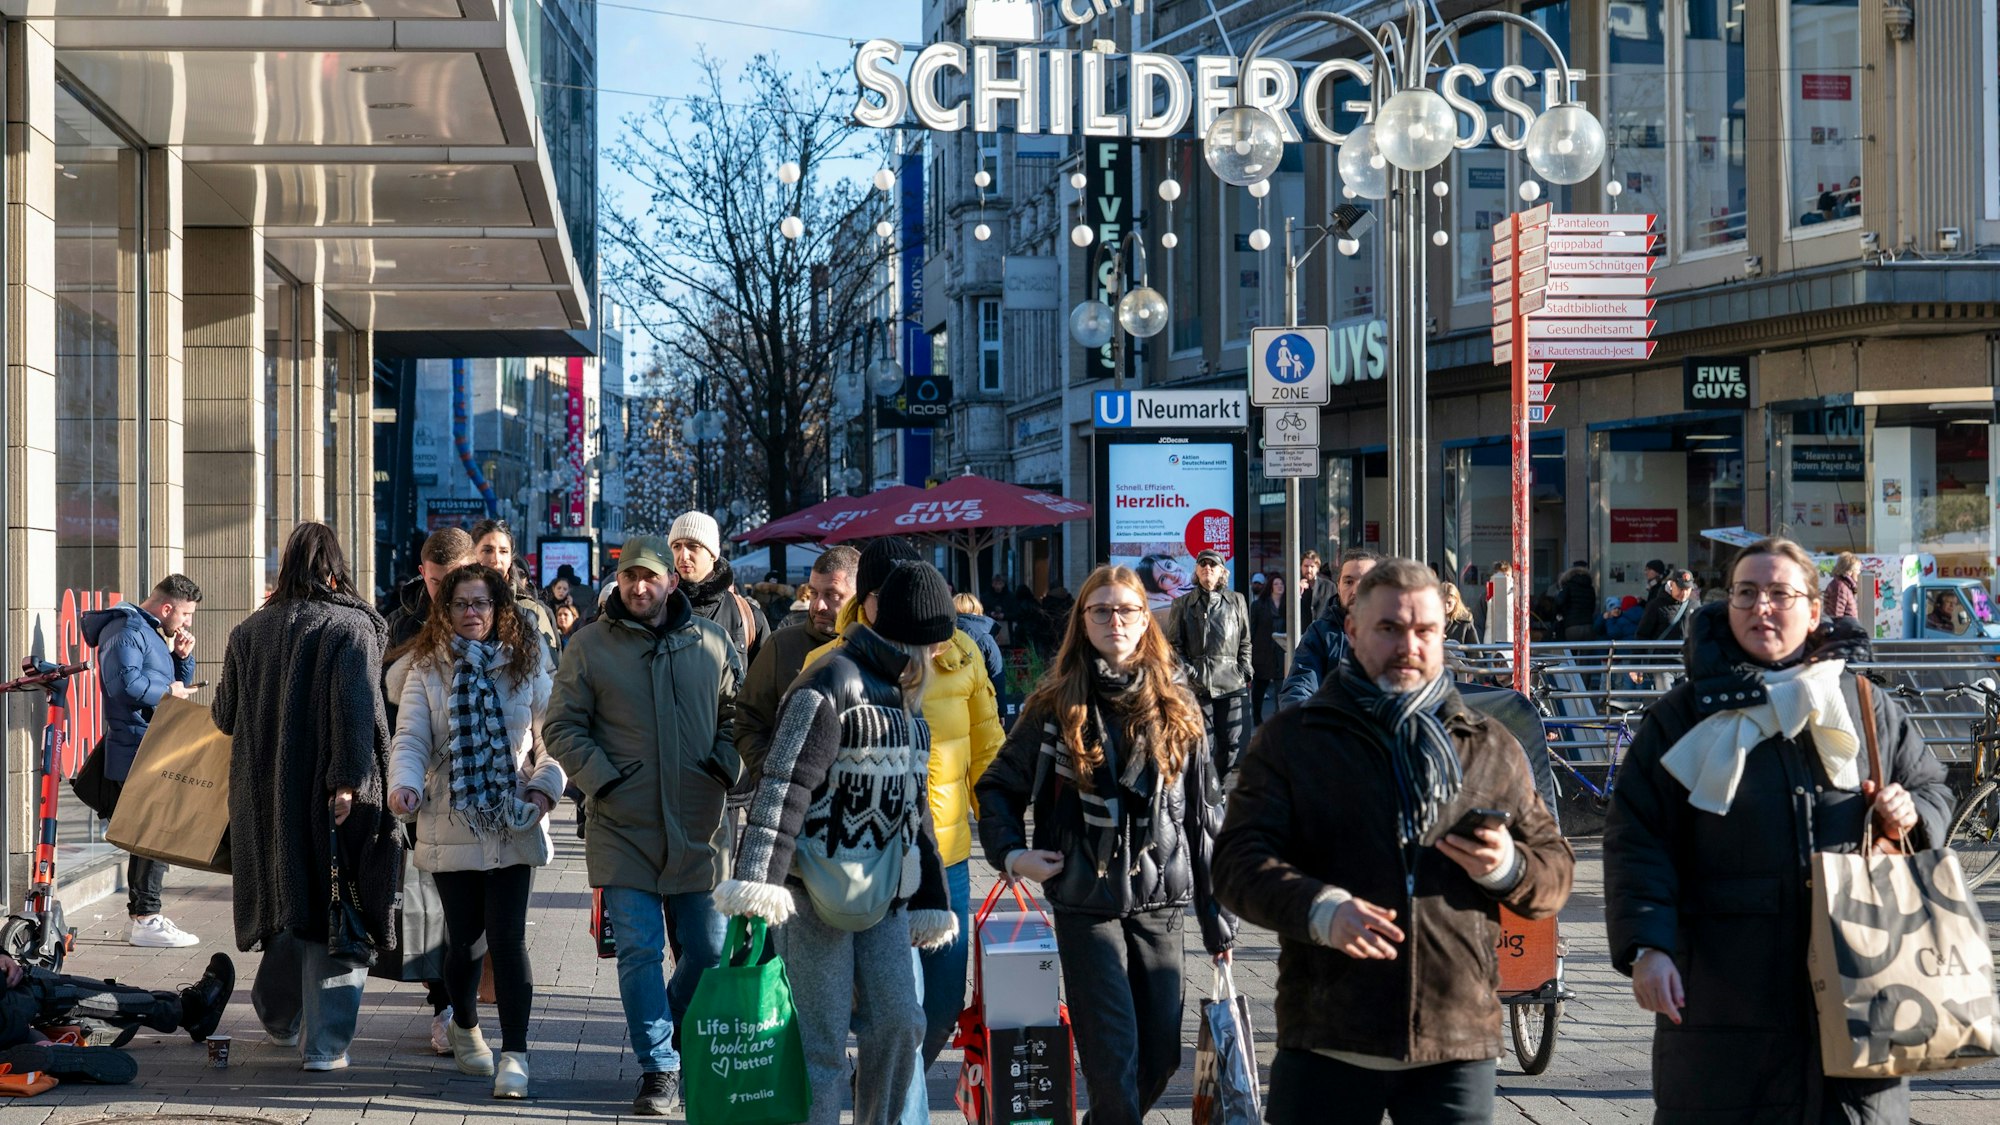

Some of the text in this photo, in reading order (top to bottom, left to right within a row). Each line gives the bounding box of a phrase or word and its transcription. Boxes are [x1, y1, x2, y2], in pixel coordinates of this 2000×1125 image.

[852, 38, 1587, 150] SCHILDERGSS
[1098, 143, 1122, 249] FIVE
[1558, 218, 1609, 228] Pantaleon
[1548, 239, 1603, 251] grippabad
[1589, 260, 1644, 272] Schnütgen
[1548, 282, 1569, 291] VHS
[1547, 303, 1627, 313] Stadtbibliothek
[1547, 324, 1633, 335] Gesundheitsamt
[1548, 346, 1634, 357] Rautenstrauch-Joest
[1697, 366, 1741, 382] FIVE
[1272, 387, 1309, 399] ZONE
[1692, 383, 1747, 399] GUYS
[909, 404, 947, 416] IQOS
[1101, 395, 1241, 424] U Neumarkt
[1283, 433, 1300, 442] frei
[909, 499, 982, 513] FIVE
[1116, 494, 1190, 508] Herzlich.
[894, 510, 985, 526] GUYS
[161, 770, 214, 789] RESERVED
[1915, 944, 1971, 978] C&A
[697, 1019, 729, 1035] Life
[735, 1018, 747, 1034] is
[710, 1035, 776, 1055] books are
[733, 1054, 774, 1070] better
[739, 1089, 775, 1103] Thalia
